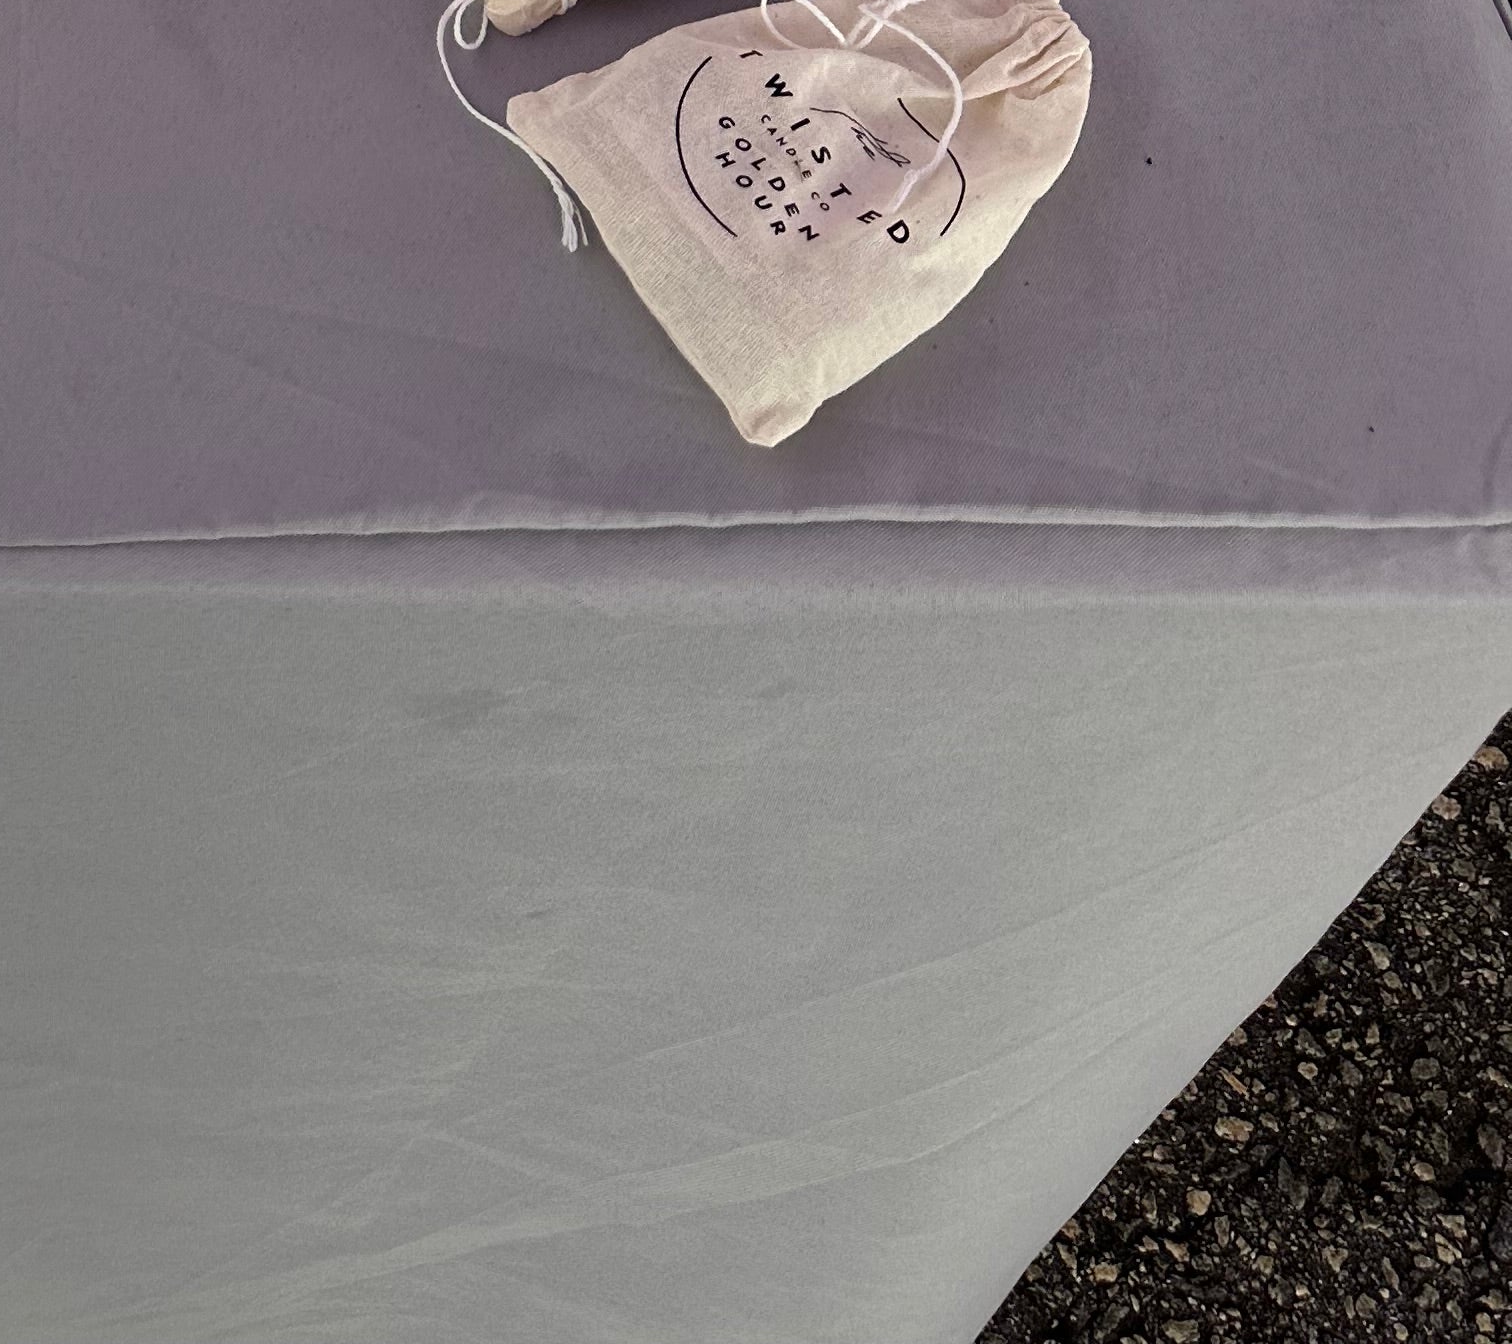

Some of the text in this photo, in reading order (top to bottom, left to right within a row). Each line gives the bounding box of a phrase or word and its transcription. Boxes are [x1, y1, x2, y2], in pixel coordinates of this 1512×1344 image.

[714, 152, 786, 236] HOUR
[718, 116, 820, 242] GOLDEN
[739, 49, 910, 243] TWISTED
[761, 114, 830, 211] CANDLE CO
